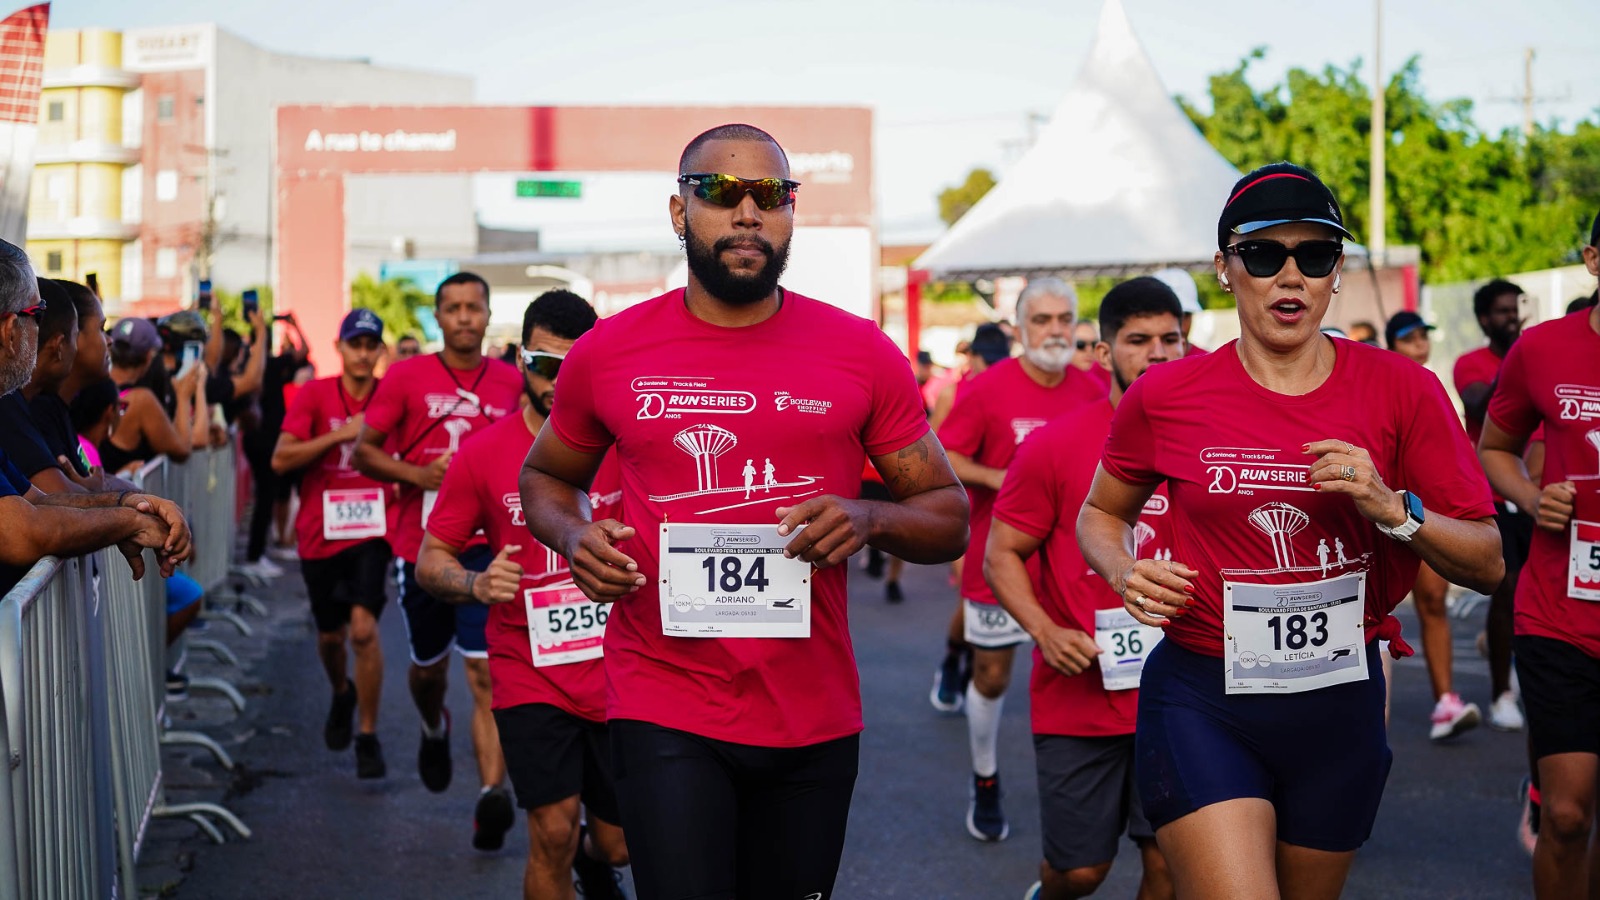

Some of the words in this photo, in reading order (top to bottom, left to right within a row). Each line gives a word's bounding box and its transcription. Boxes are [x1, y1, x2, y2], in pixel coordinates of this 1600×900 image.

[304, 129, 323, 152] A
[636, 393, 665, 420] 20
[790, 398, 833, 408] BOULEVARD
[1206, 466, 1237, 494] 20
[335, 504, 373, 520] 5309
[702, 556, 769, 593] 184
[715, 596, 756, 604] ADRIANO
[548, 603, 609, 633] 5256
[1267, 611, 1329, 651] 183
[1111, 630, 1143, 657] 36
[1284, 651, 1315, 661] LETÍCIA
